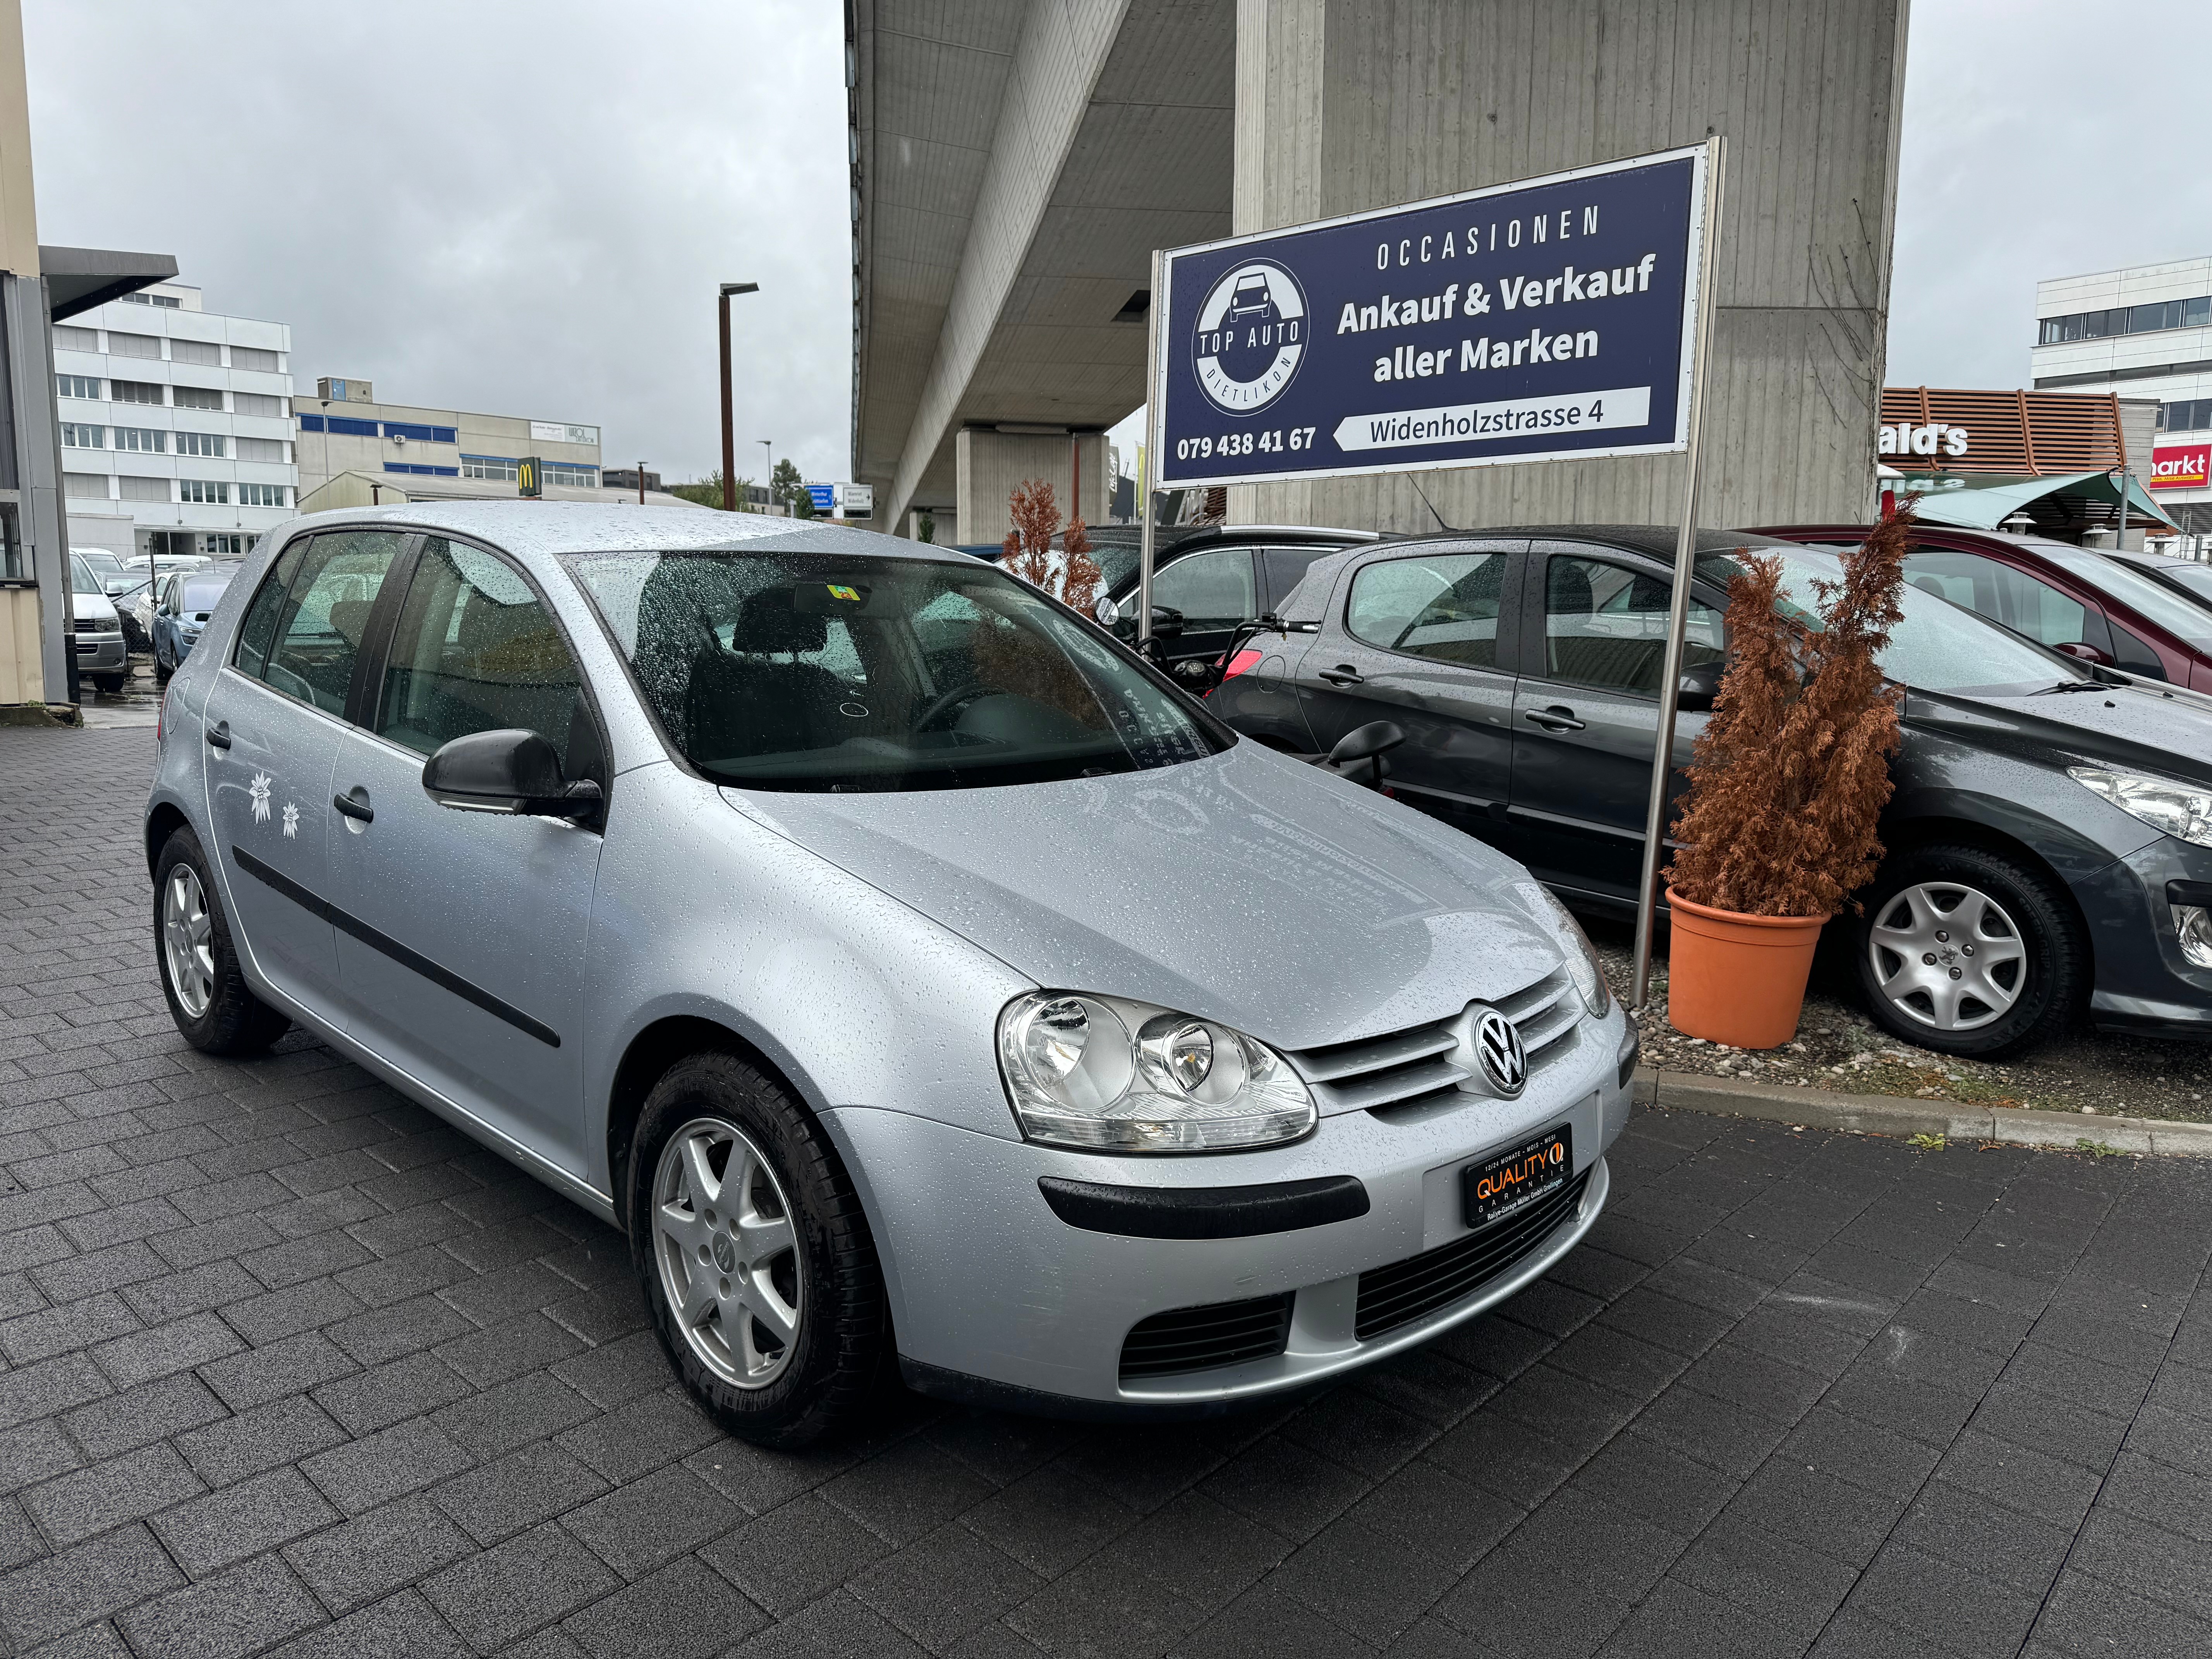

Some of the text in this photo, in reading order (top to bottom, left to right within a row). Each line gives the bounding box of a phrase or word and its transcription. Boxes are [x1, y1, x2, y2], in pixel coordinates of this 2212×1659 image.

[1377, 205, 1598, 270] OCCASIONEN
[1337, 253, 1656, 335] Ankauf & Verkauf
[1200, 321, 1298, 354] TOP AUTO
[1374, 328, 1598, 382] aller Marken
[1206, 357, 1290, 402] DIETLIKON
[1370, 399, 1604, 443] Widenholzstrasse 4
[1177, 427, 1316, 460] 079 438 41 67
[1477, 1149, 1548, 1199] QUALITY
[1485, 1161, 1499, 1172] 12/24
[1501, 1151, 1521, 1164] MONATE
[1527, 1142, 1539, 1152] MOIS
[1544, 1134, 1556, 1144] MESI
[1487, 1178, 1563, 1221] Rallye-Garage Müller GmbH Grellingen
